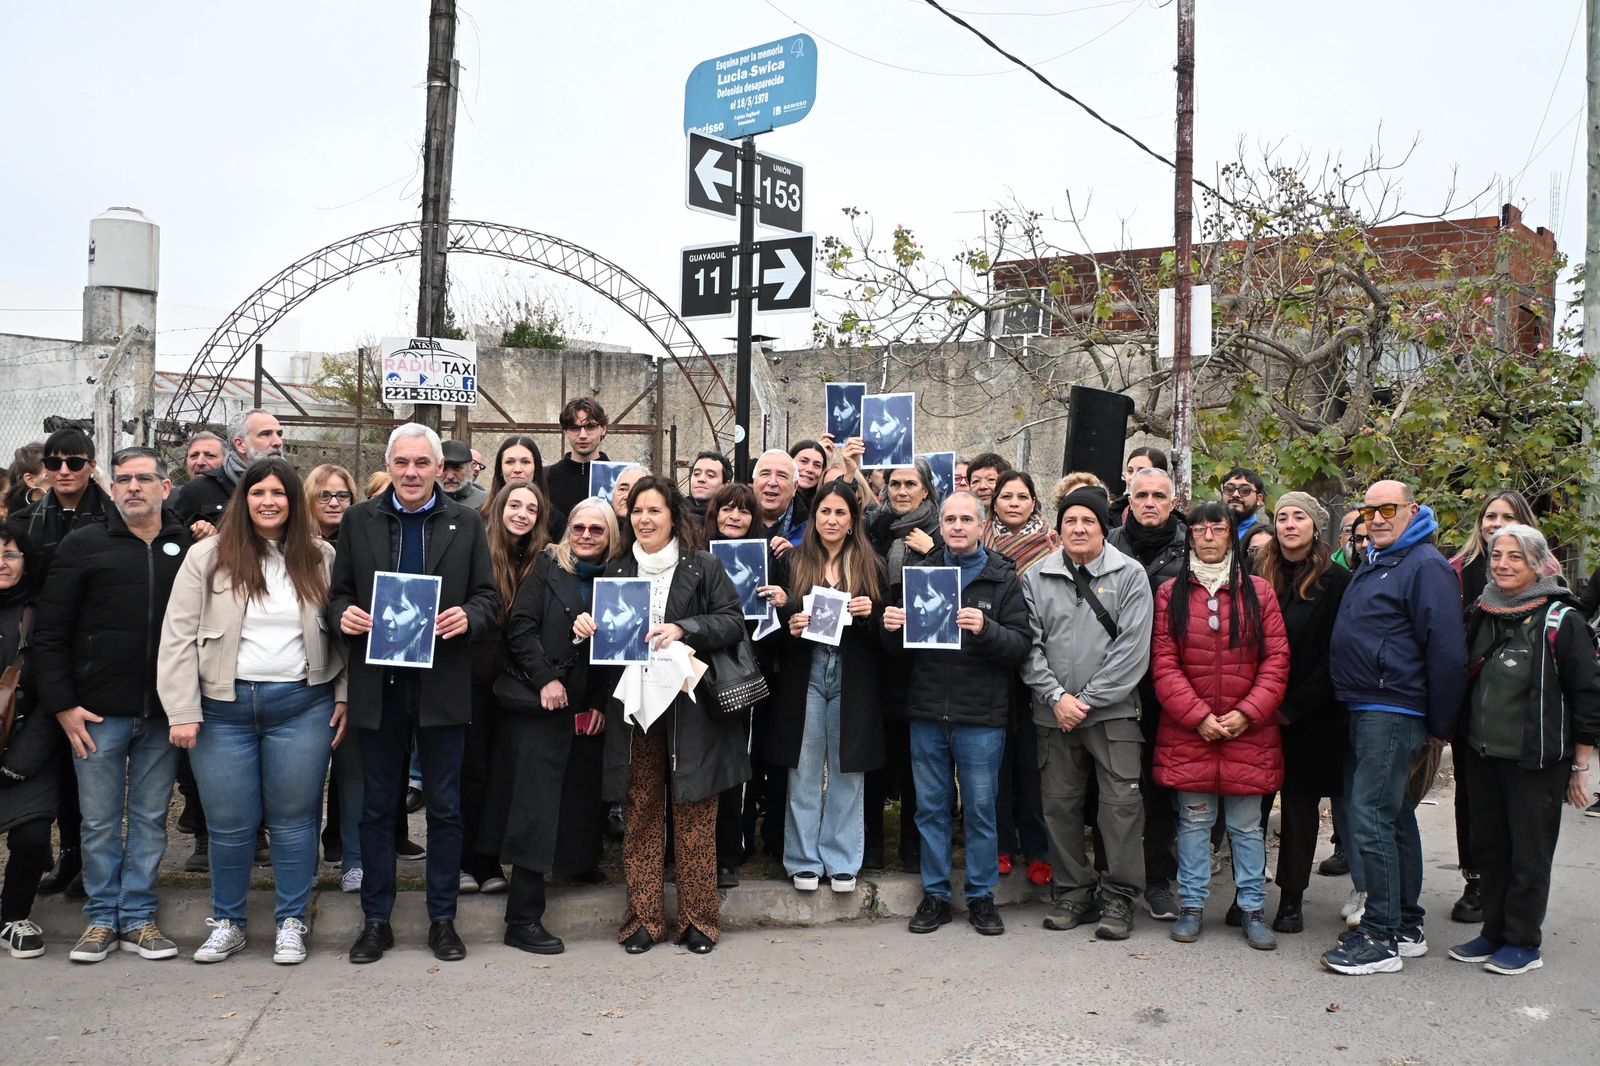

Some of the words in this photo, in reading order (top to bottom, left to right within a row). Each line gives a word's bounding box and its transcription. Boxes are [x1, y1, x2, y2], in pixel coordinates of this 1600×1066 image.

[716, 57, 739, 71] Esquina
[740, 54, 750, 66] por
[751, 52, 757, 61] la
[757, 44, 784, 59] memoria
[751, 60, 785, 77] Swica
[717, 84, 743, 98] Detenida
[744, 74, 785, 91] desaparecida
[730, 99, 736, 110] el
[762, 177, 801, 212] 153
[689, 251, 727, 263] GUAYAQUIL
[694, 266, 721, 296] 11
[384, 358, 441, 373] RADIO
[442, 361, 476, 376] TAXI
[386, 387, 475, 403] 221-3180303
